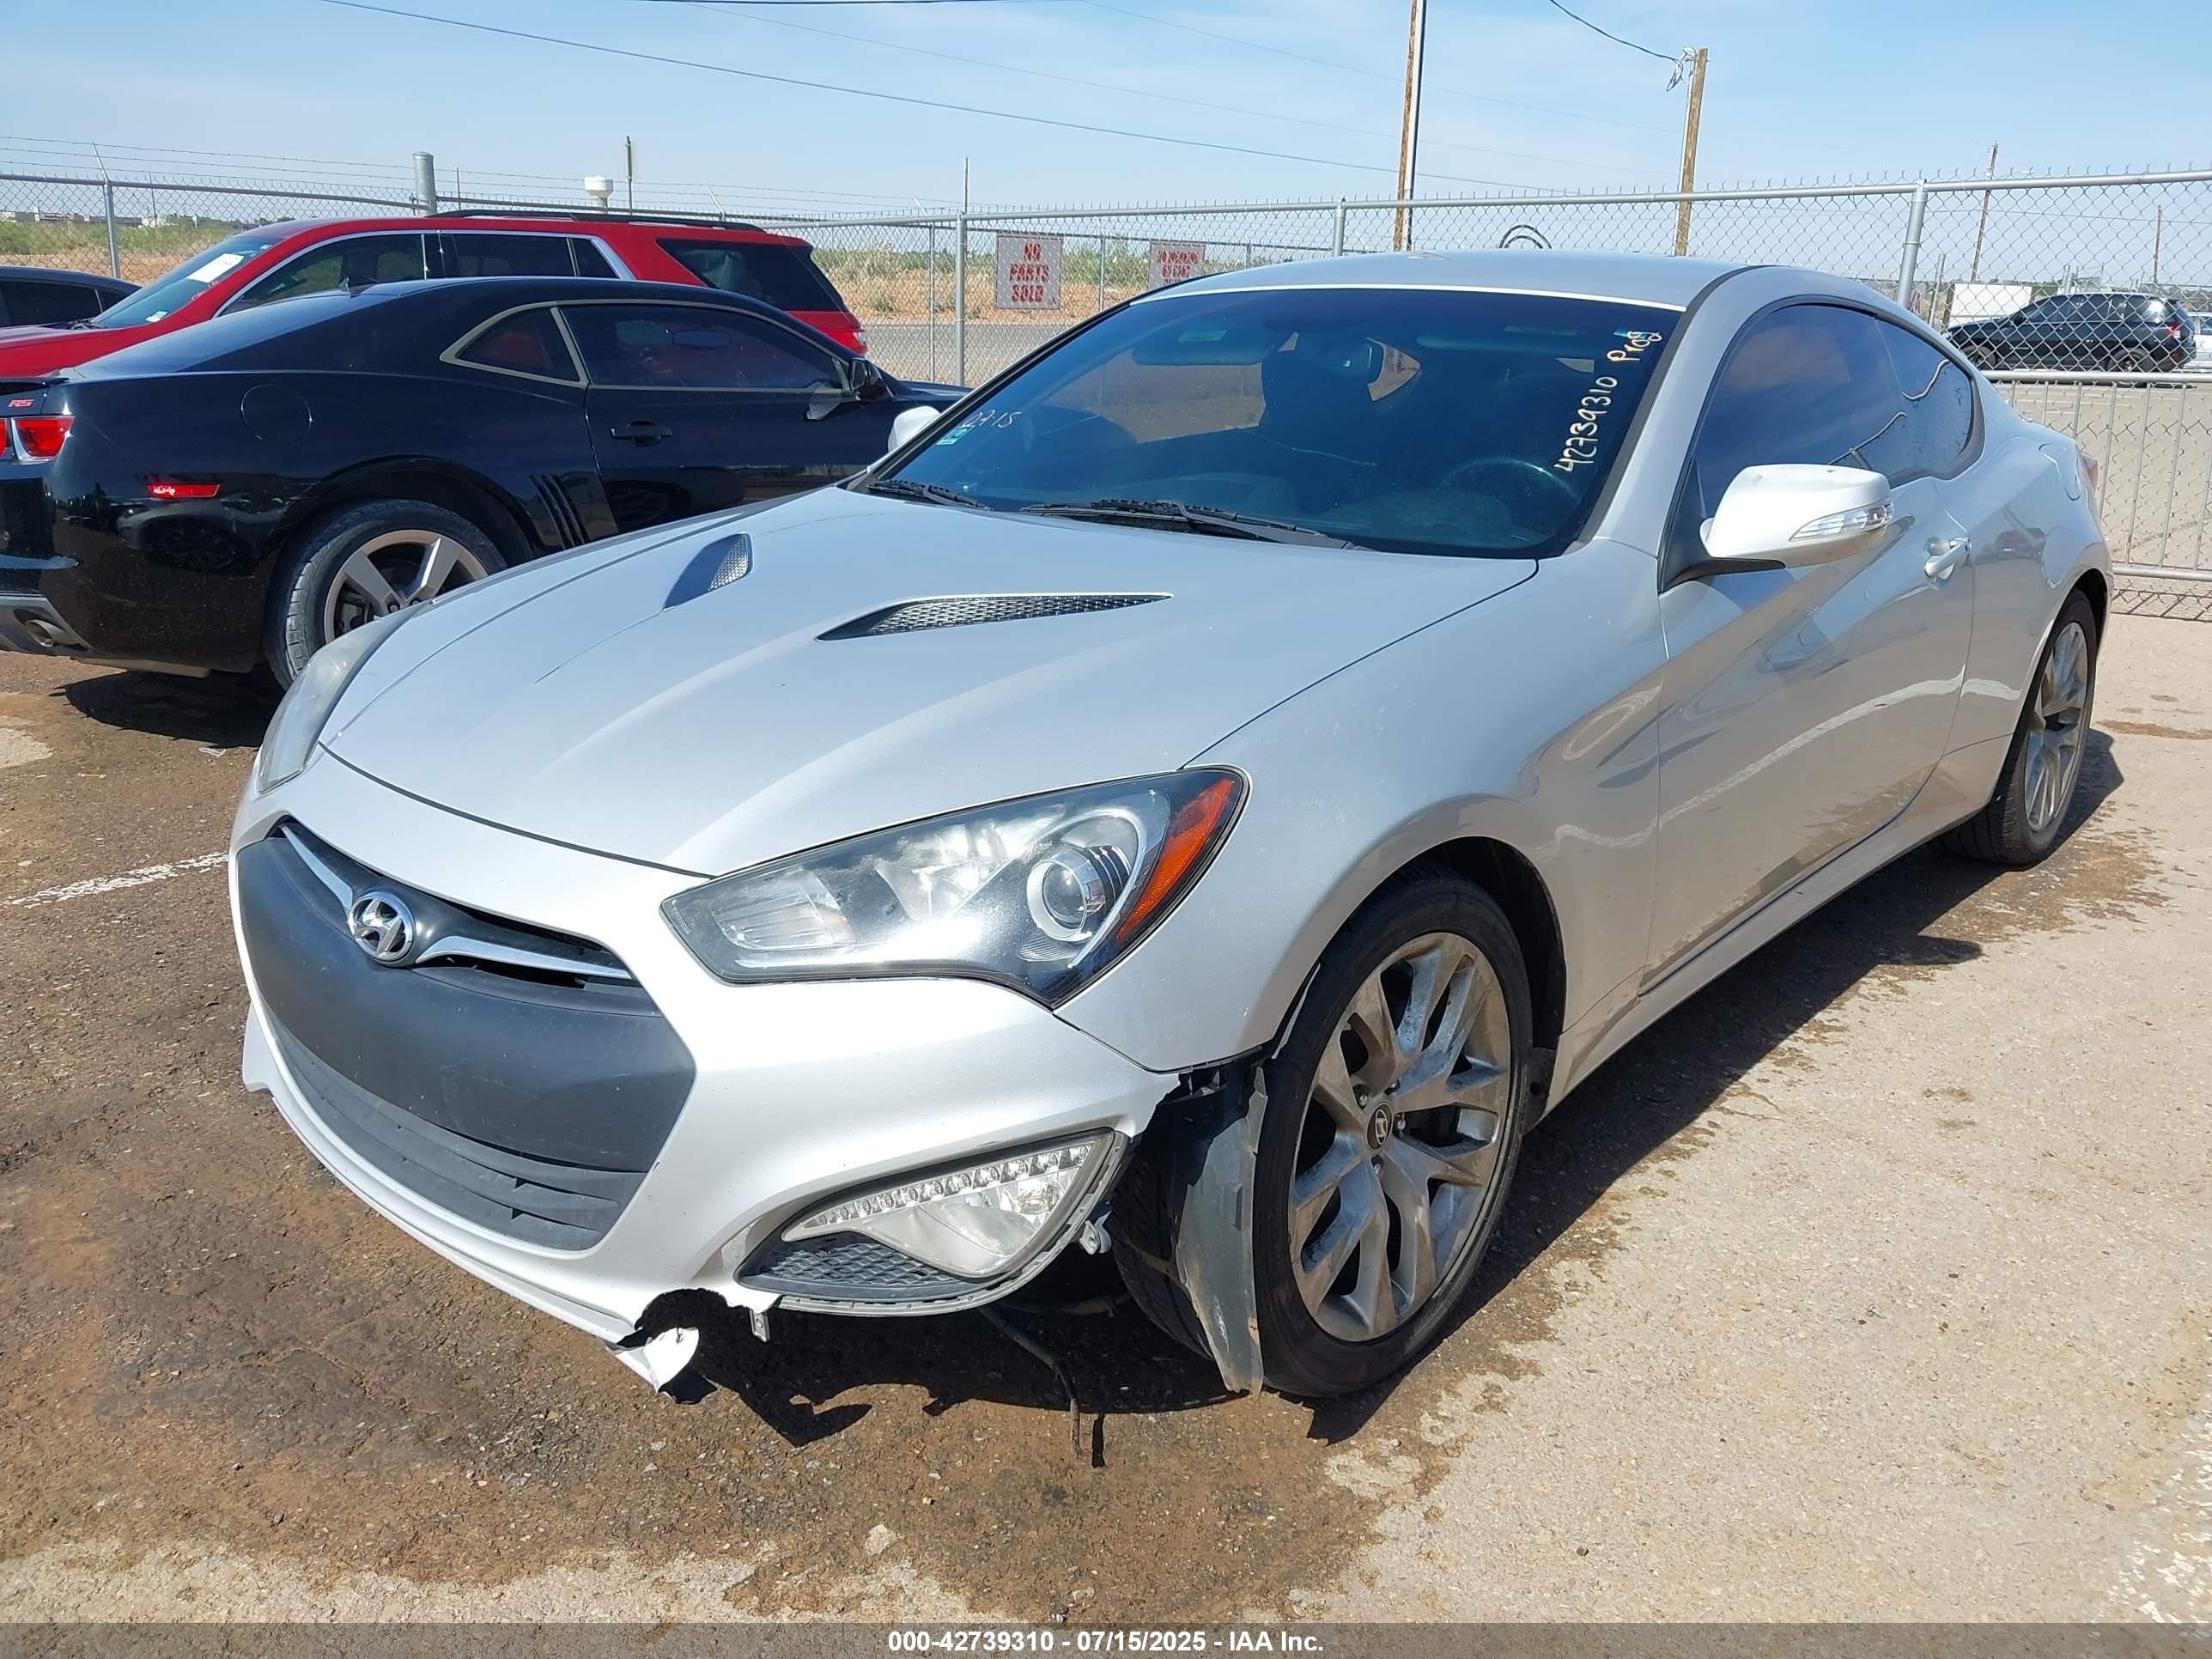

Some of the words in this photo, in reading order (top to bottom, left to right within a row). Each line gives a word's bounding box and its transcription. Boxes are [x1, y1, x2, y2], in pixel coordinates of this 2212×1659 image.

[1024, 243, 1042, 262] NO
[1009, 263, 1049, 283] PARTS
[1012, 283, 1044, 303] SOLD
[8, 398, 34, 408] RS
[1553, 376, 1618, 471] 42739310
